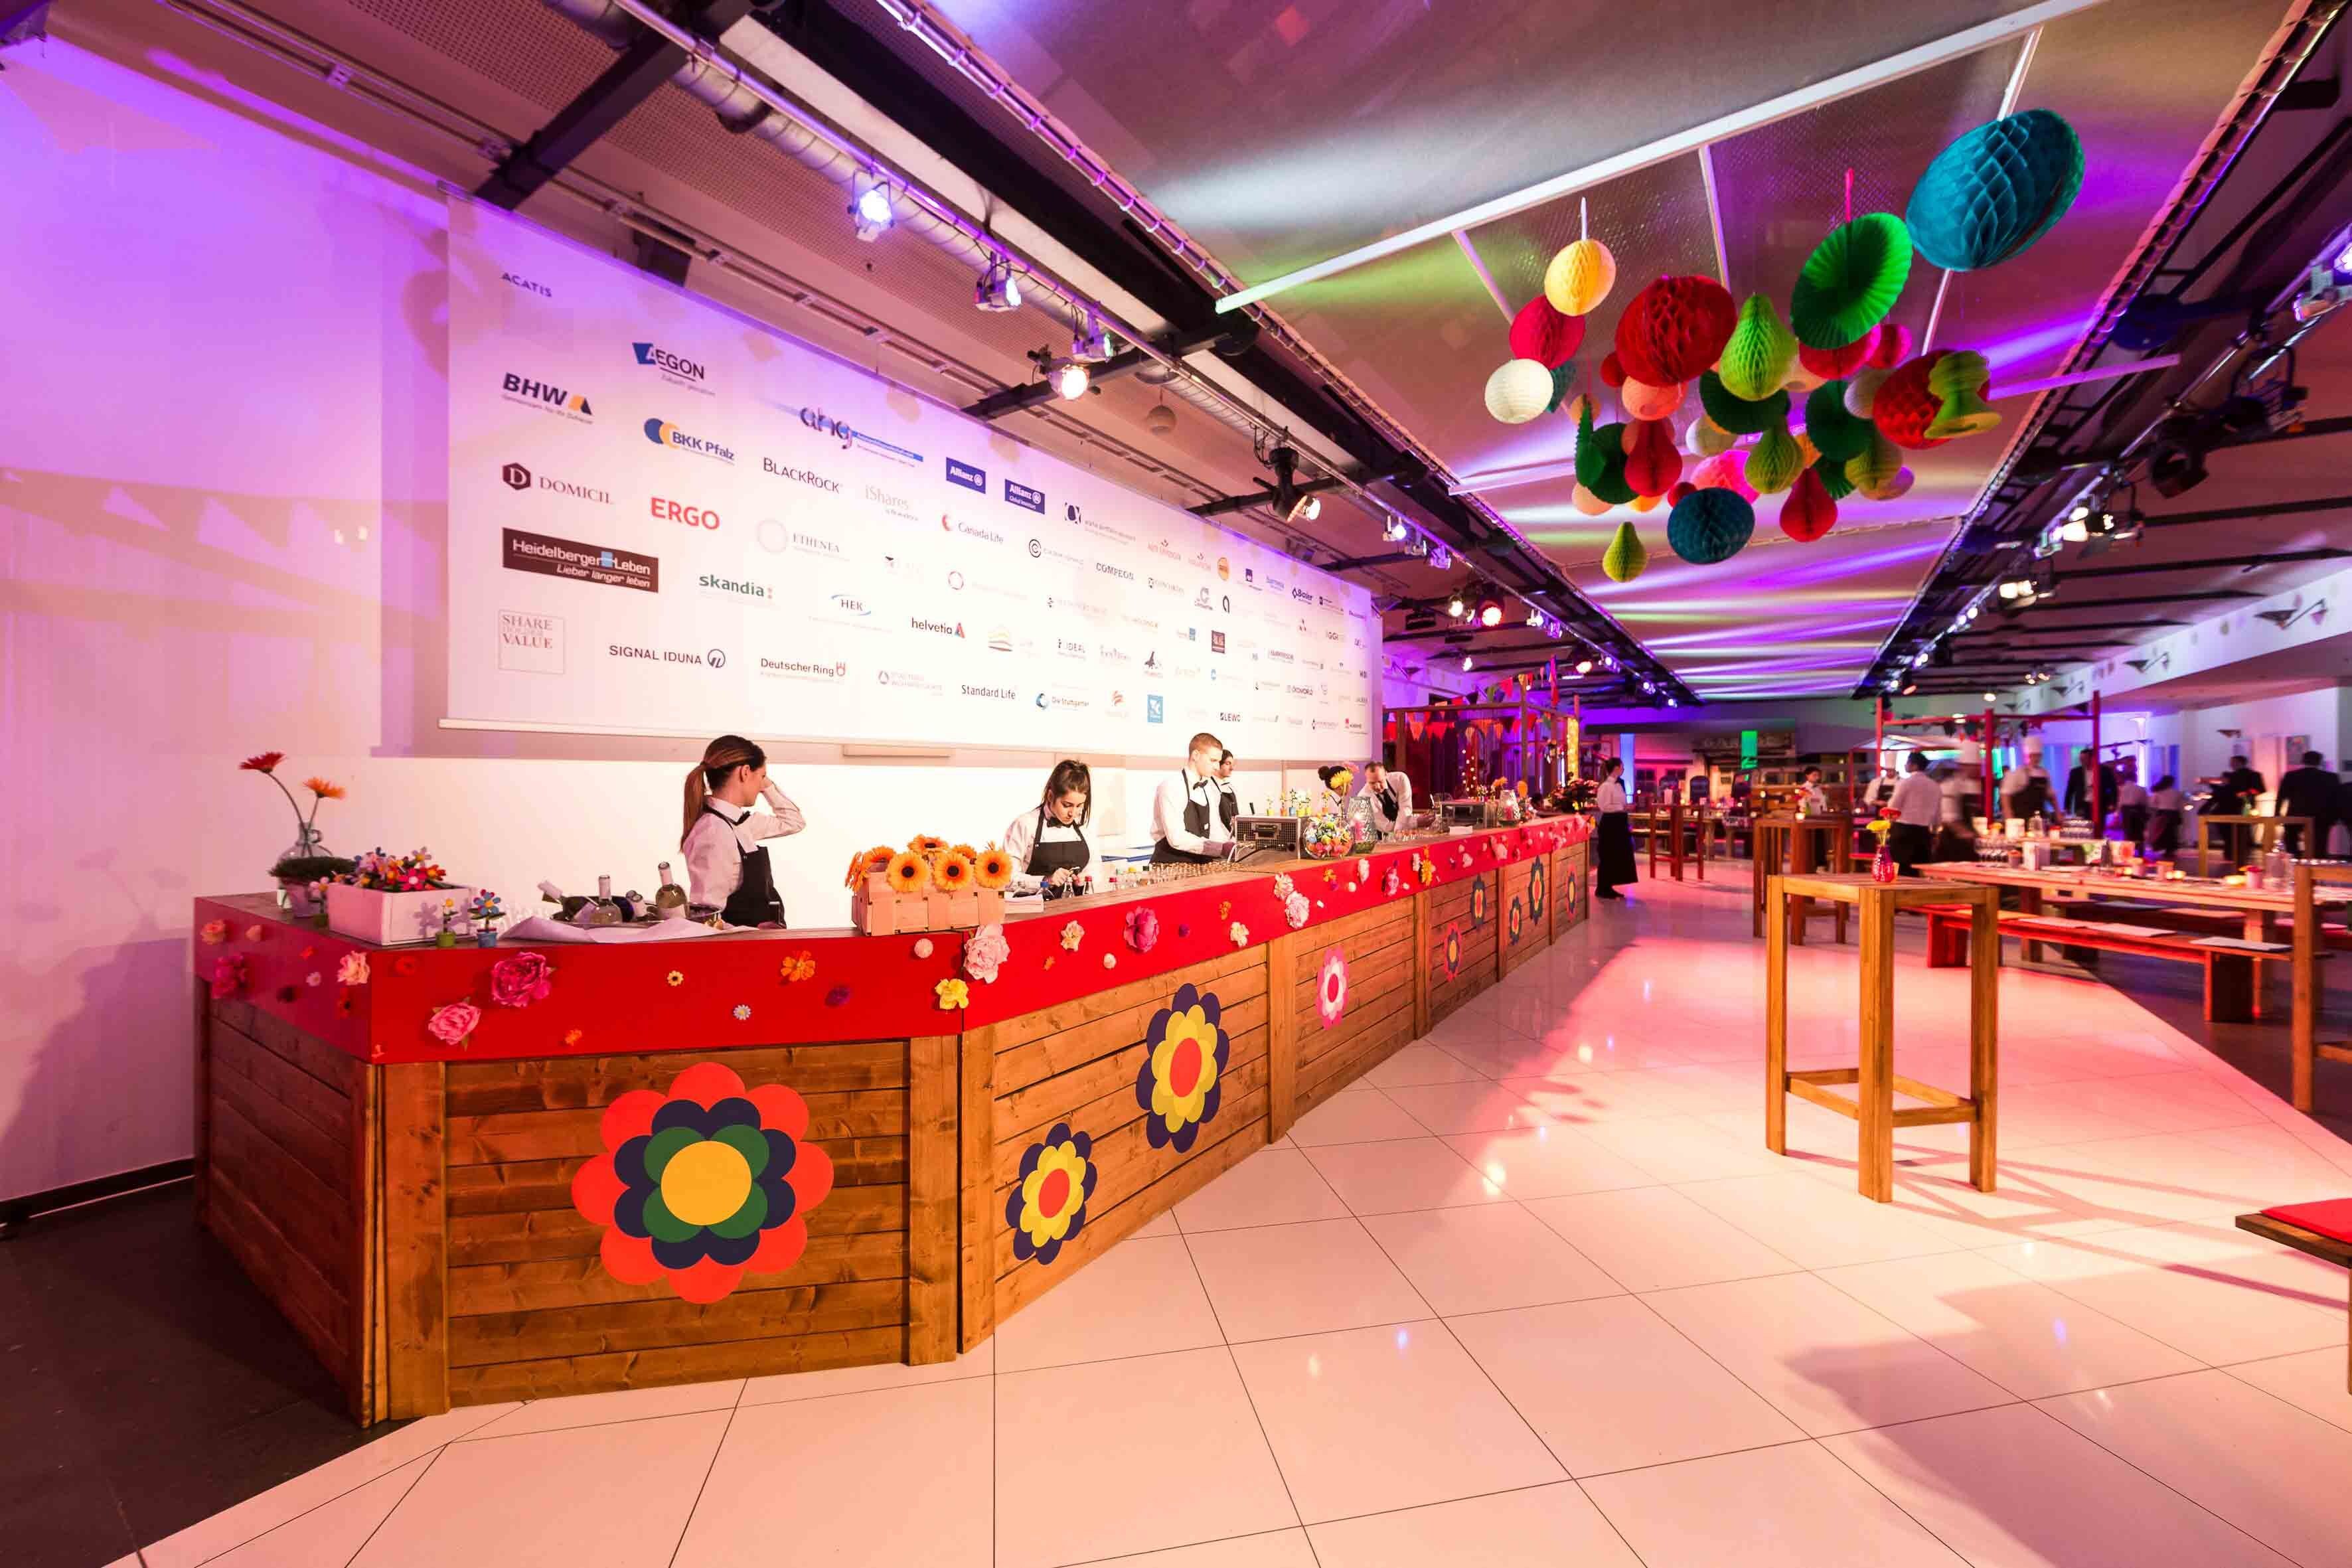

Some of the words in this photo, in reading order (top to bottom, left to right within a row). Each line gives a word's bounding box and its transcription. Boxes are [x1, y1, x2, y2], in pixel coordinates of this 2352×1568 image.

[501, 272, 553, 298] ACATIS
[645, 345, 705, 380] AEGON
[503, 372, 568, 406] BHW
[672, 431, 703, 451] BKK
[706, 441, 735, 460] Pfalz
[950, 465, 975, 482] Allianz
[1009, 483, 1032, 500] Allianz
[650, 496, 721, 530] ERGO
[959, 522, 989, 541] Canada
[512, 539, 603, 567] Heidelberger
[613, 558, 651, 576] Leben
[556, 564, 589, 578] Lieber
[626, 575, 650, 588] leben
[840, 598, 864, 611] HEK
[503, 615, 553, 631] SHARE
[911, 616, 953, 635] helvetia
[503, 633, 553, 649] VALUE
[609, 645, 660, 661] SIGNAL
[663, 651, 702, 665] IDUNA
[760, 658, 811, 673] Deutscher
[813, 664, 834, 677] Ring
[961, 684, 998, 698] Standard
[1000, 688, 1016, 700] Life
